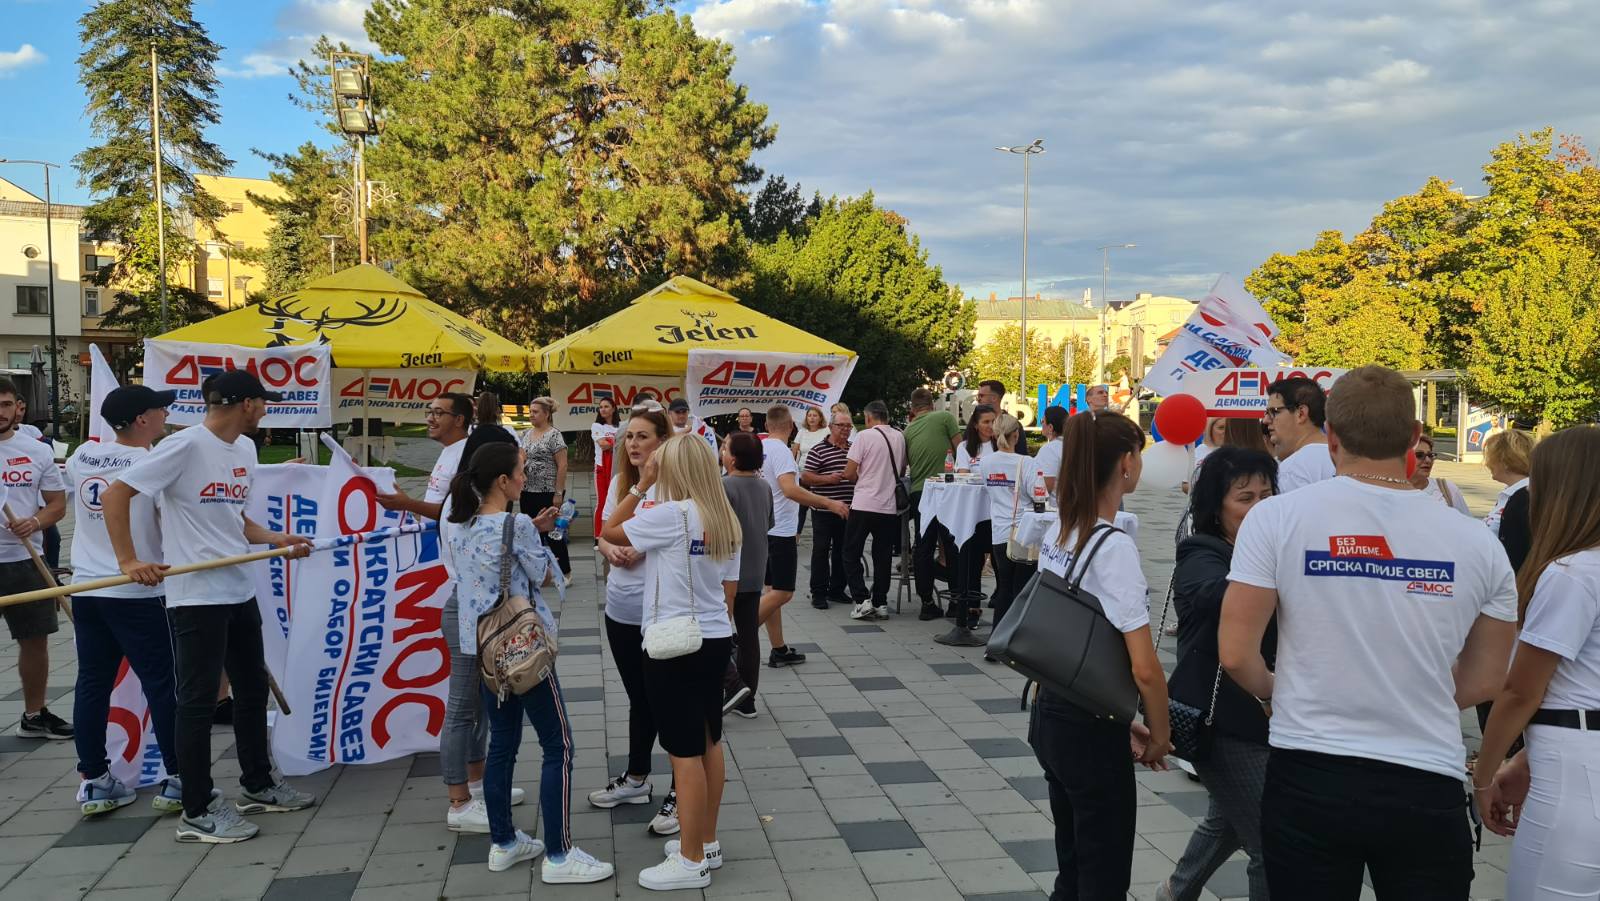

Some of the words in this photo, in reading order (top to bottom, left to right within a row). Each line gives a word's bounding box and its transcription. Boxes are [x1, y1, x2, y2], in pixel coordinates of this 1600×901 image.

[654, 325, 758, 344] Jelen
[401, 352, 442, 368] Jelen
[593, 350, 633, 367] Jelen
[702, 361, 834, 390] ДЕМОС
[700, 387, 789, 397] ДЕМОКРАТСКИ
[790, 389, 827, 404] САВЕЗ
[1215, 398, 1267, 408] ДЕМОКРА
[267, 406, 318, 415] БИЈЕЉИНА
[88, 483, 101, 506] 1
[1336, 537, 1356, 546] БЕЗ
[1309, 560, 1363, 572] СРПСКА
[1406, 567, 1450, 580] СВЕГА
[325, 579, 351, 660] ОДБОР
[307, 667, 337, 761] БИЈЕЉИН
[340, 680, 371, 763] САВЕЗ
